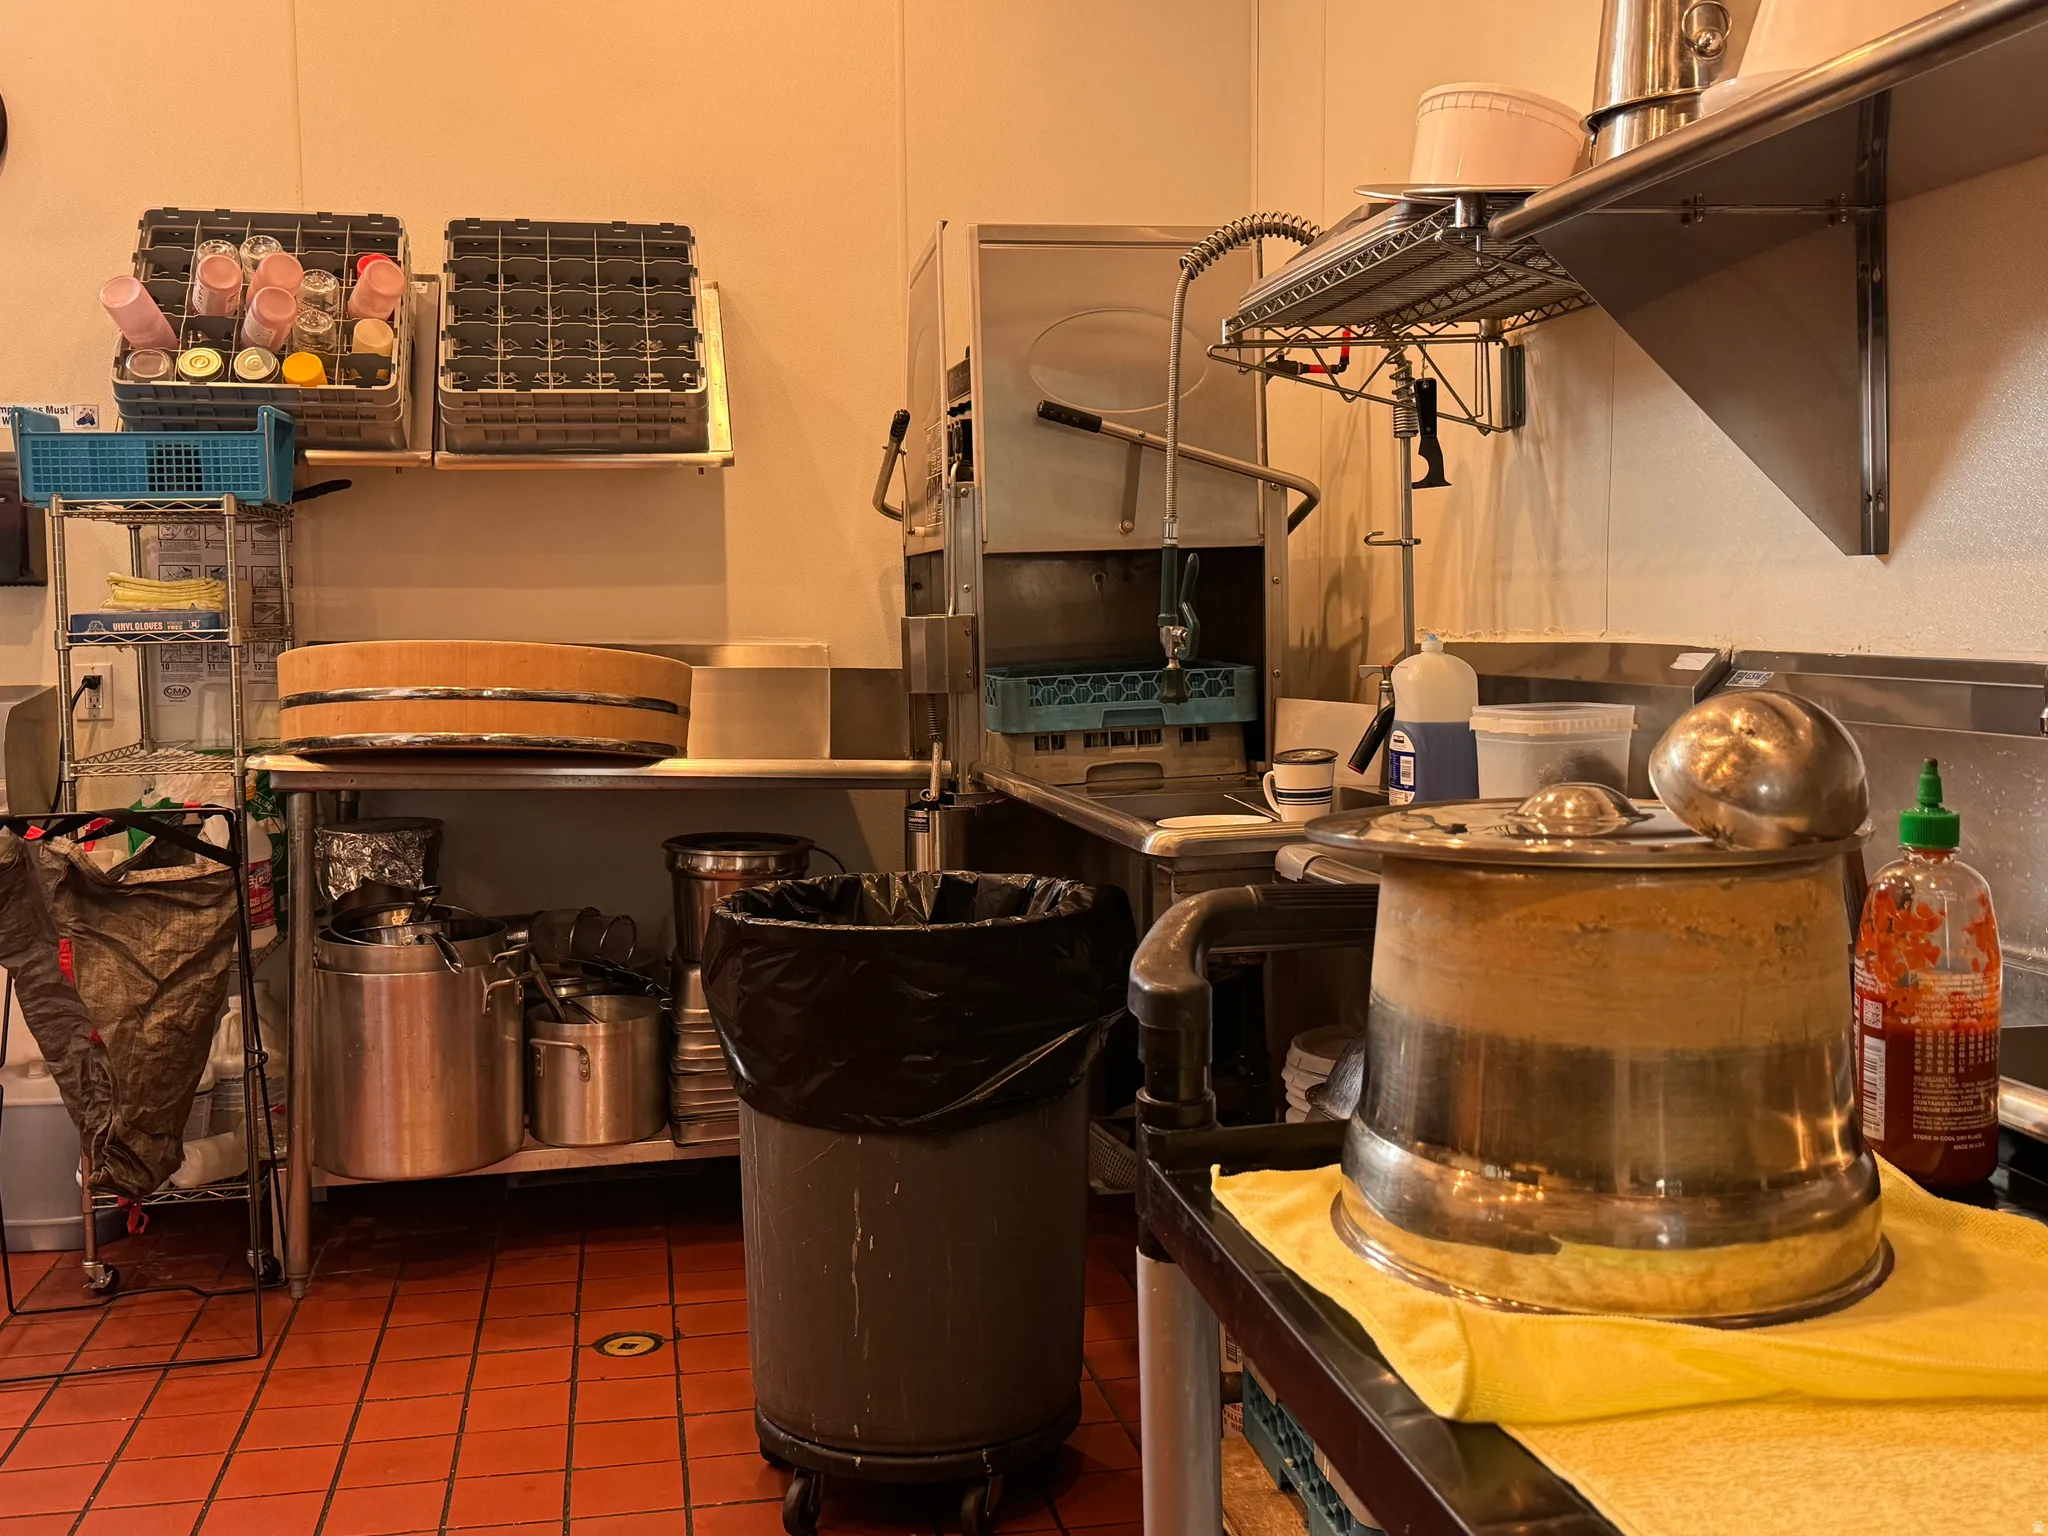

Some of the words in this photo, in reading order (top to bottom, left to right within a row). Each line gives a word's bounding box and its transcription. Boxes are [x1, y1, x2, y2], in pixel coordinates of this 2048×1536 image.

[46, 405, 69, 414] Must
[113, 622, 134, 631] VINYL
[135, 621, 163, 631] GLOVES
[166, 687, 188, 695] CMA
[1913, 1099, 1945, 1107] CONTAINS
